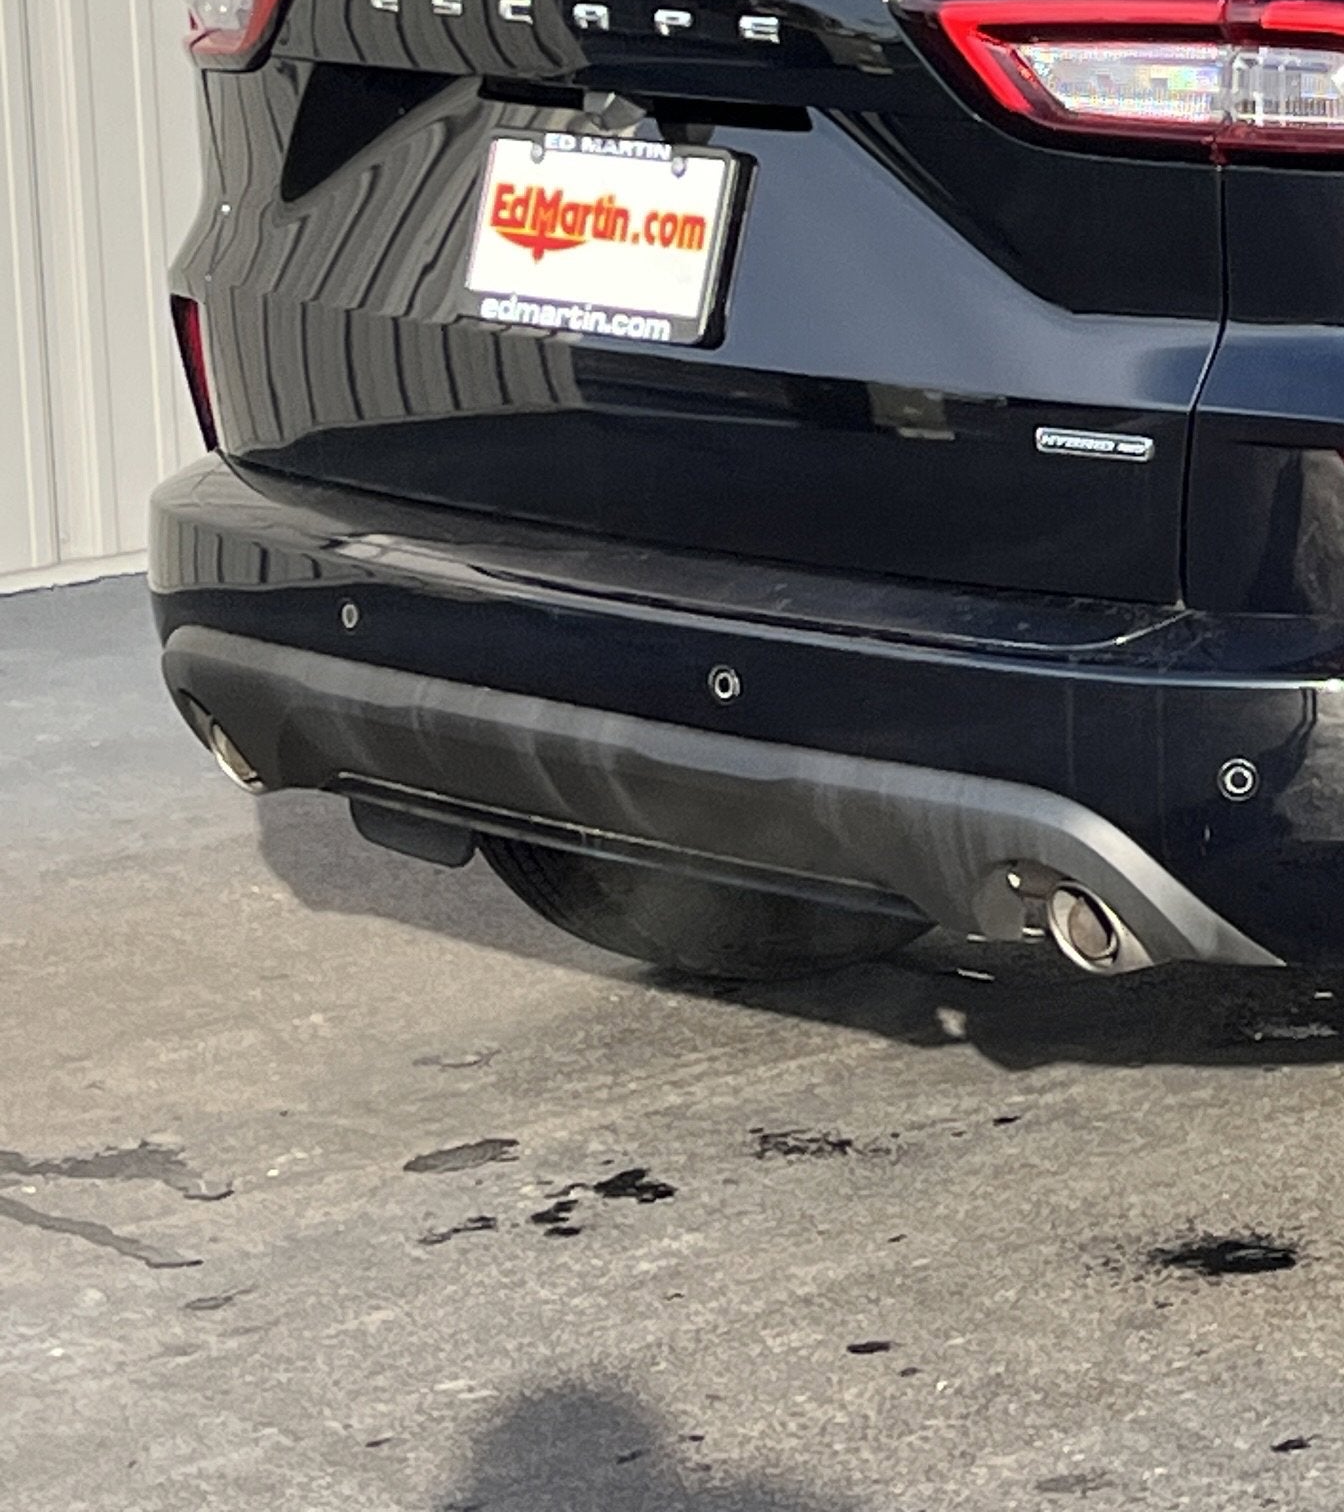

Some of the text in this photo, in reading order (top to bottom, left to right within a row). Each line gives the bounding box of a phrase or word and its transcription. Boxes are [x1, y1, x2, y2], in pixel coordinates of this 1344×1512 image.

[545, 132, 672, 162] ED MARTIN
[490, 182, 707, 251] EdMartin.com
[480, 292, 671, 342] edmartin.com
